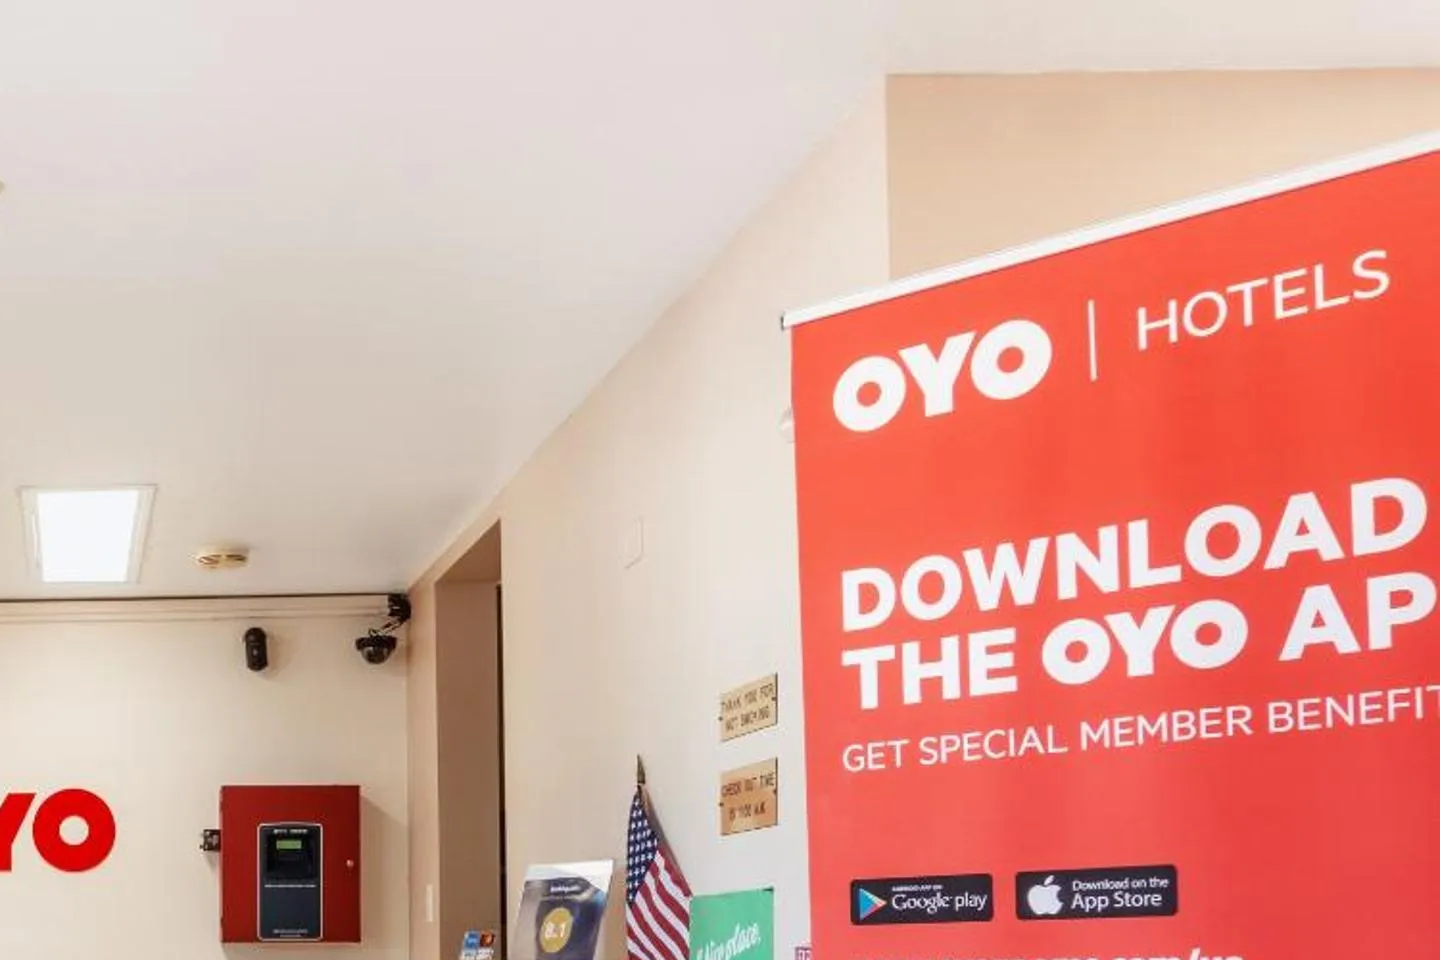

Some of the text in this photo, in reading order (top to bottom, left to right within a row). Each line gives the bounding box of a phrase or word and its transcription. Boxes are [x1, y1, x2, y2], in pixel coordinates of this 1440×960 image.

[833, 250, 1390, 432] OYO HOTELS
[841, 477, 1427, 632] DOWNLOAD
[841, 627, 1018, 710] THE
[1042, 599, 1249, 685] OYO
[842, 739, 909, 772] GET
[919, 725, 1068, 765] SPECIAL
[1080, 705, 1253, 750] MEMBER
[891, 891, 988, 914] Google play
[1070, 891, 1163, 912] App Store
[1072, 877, 1170, 892] Download on the
